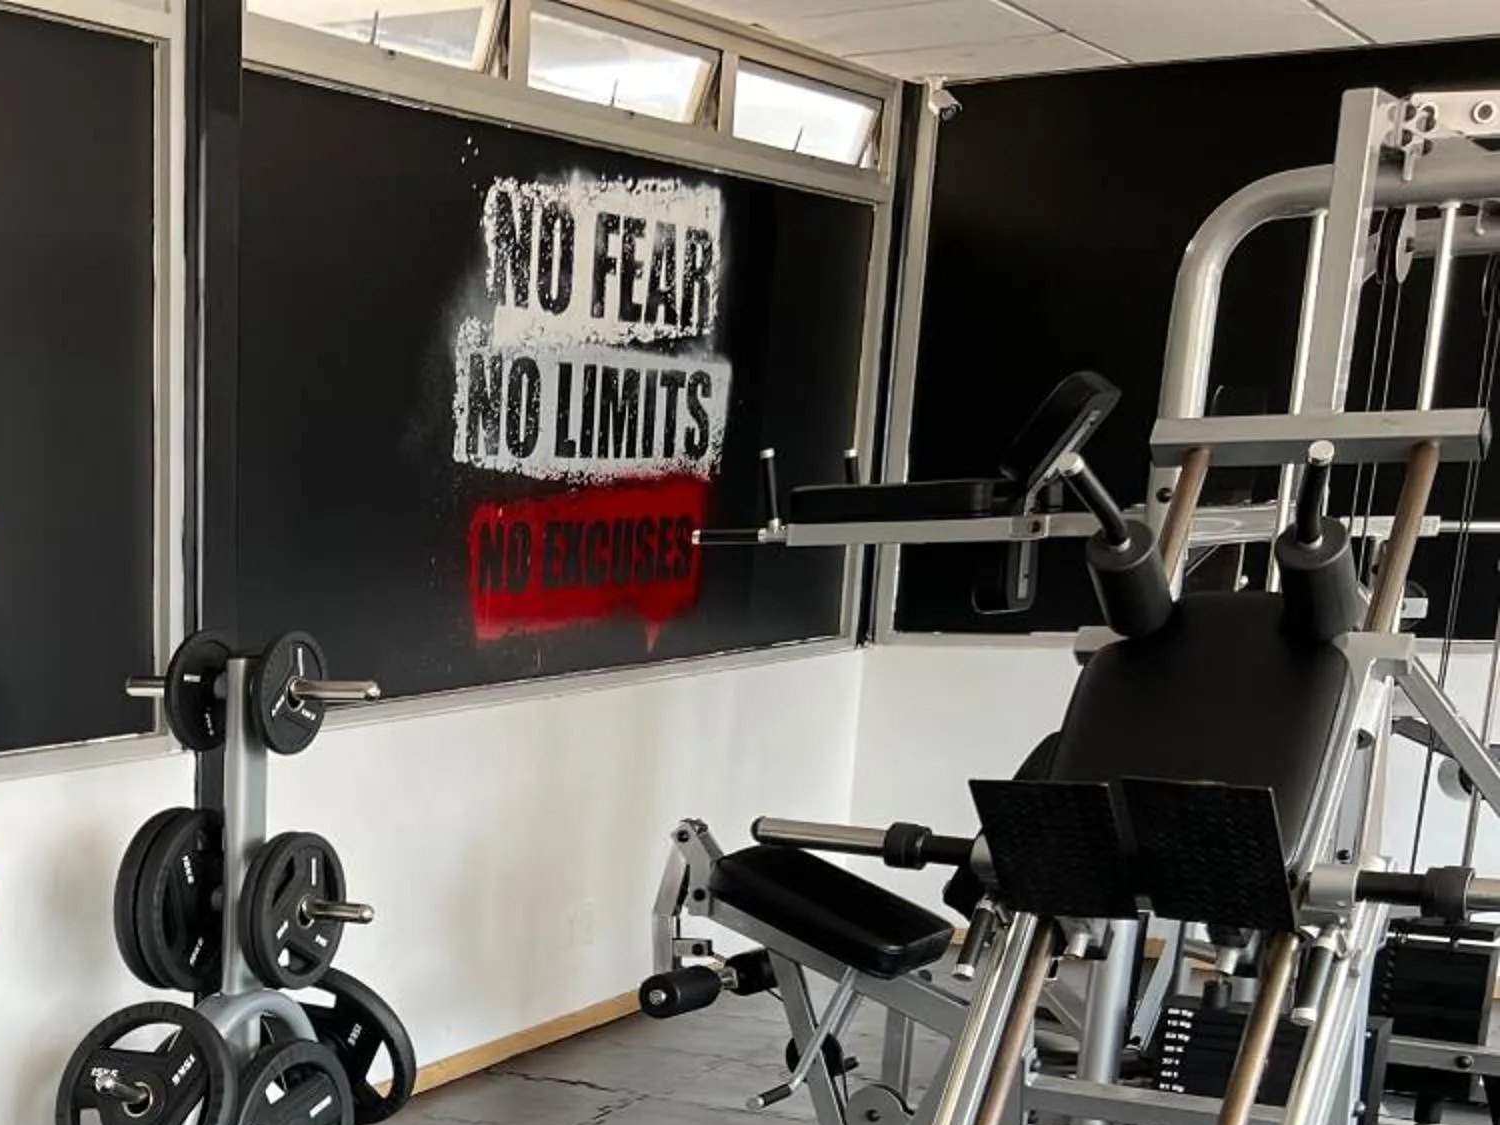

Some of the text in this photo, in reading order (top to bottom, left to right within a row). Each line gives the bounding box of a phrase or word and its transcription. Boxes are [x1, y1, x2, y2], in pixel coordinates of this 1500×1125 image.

[490, 190, 713, 330] NO FEAR
[465, 353, 712, 460] NO LIMITS
[478, 513, 693, 594] NO EXCUSES
